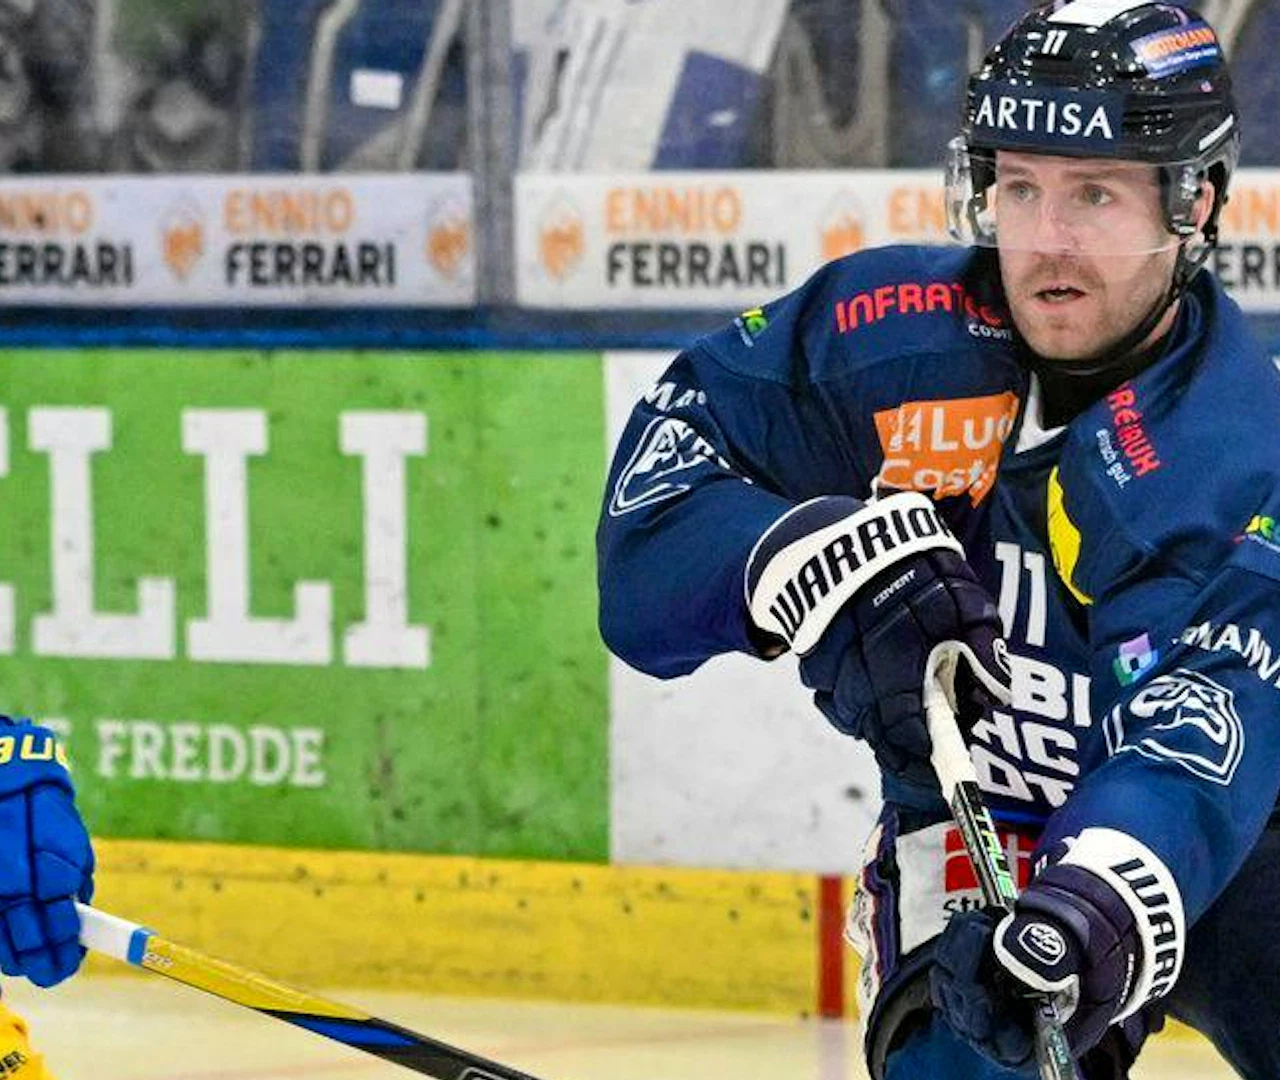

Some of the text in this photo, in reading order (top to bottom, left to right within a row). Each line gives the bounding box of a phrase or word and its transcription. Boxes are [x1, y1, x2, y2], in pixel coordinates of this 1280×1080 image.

[1041, 29, 1068, 55] 11
[974, 95, 1115, 140] ARTISA
[223, 187, 355, 235] ENNIO
[604, 187, 745, 234] ENNIO
[226, 241, 396, 287] FERRARI
[606, 241, 785, 287] FERRARI
[995, 541, 1047, 648] 11
[95, 717, 326, 789] FREDDE
[975, 806, 1019, 902] TRUE
